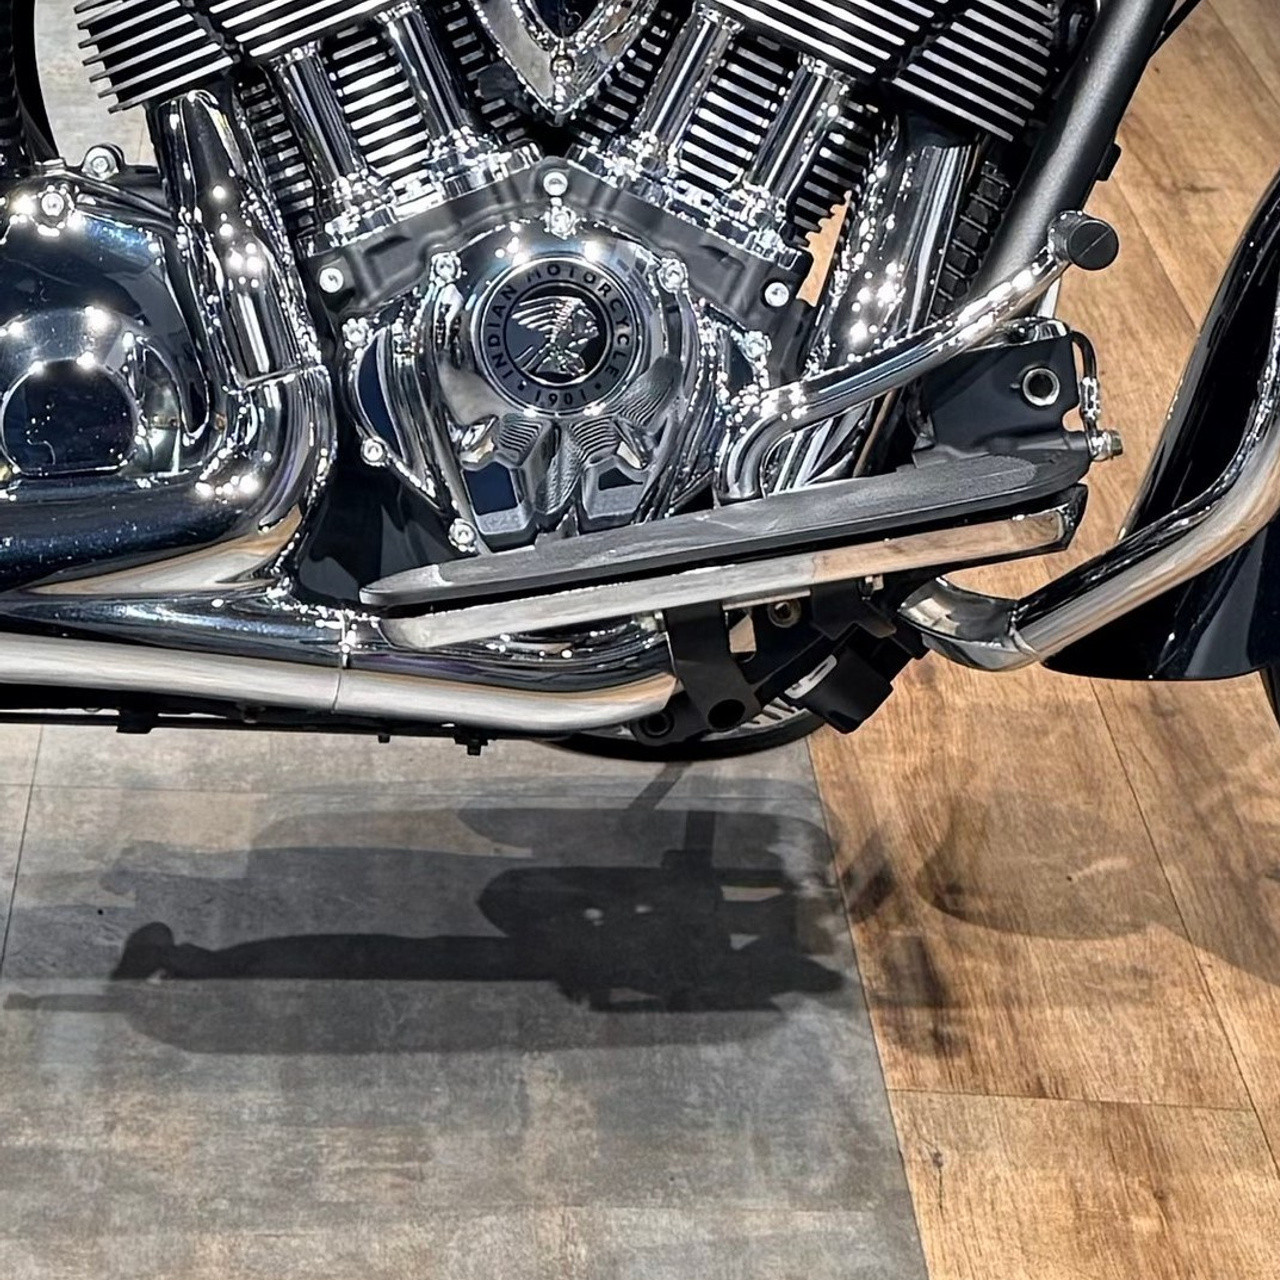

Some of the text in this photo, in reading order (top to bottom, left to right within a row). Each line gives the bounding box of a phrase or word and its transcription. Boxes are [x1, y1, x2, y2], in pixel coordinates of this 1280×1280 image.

[486, 263, 630, 380] INDIAN MOTORCYCLE
[534, 388, 587, 406] 1901
